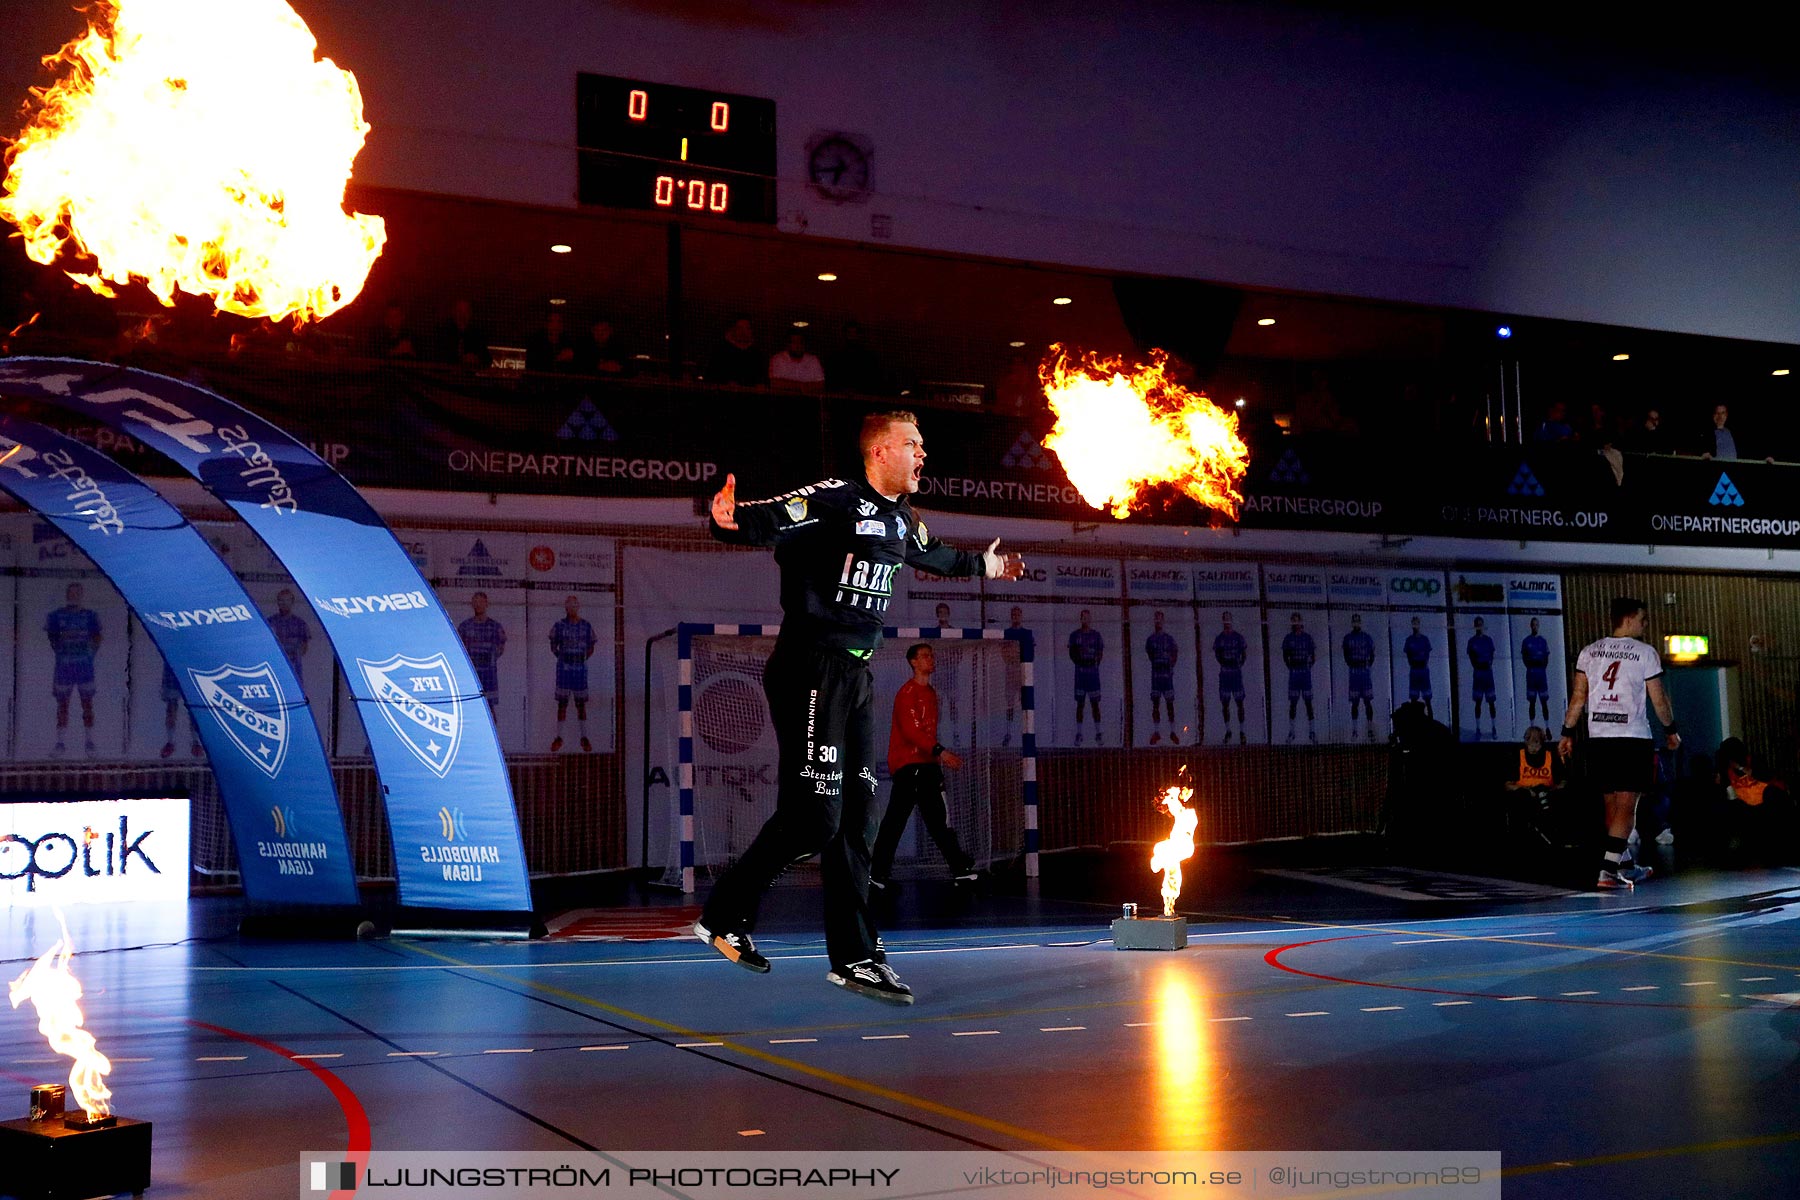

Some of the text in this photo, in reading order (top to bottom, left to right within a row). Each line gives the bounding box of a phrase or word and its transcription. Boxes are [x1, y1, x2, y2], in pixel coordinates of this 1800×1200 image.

[629, 90, 729, 132] 0 0
[447, 449, 718, 482] ONEPARTNERGROUP
[917, 474, 1082, 505] ONEPARTNERG
[1651, 514, 1800, 536] ONEPARTNERGROUP
[1056, 565, 1114, 580] SALMING
[1391, 577, 1441, 597] coop
[1510, 580, 1555, 591] SALMING
[1602, 660, 1621, 690] 4
[807, 689, 818, 739] TRAINING
[819, 745, 838, 763] 30
[814, 780, 840, 796] Buss
